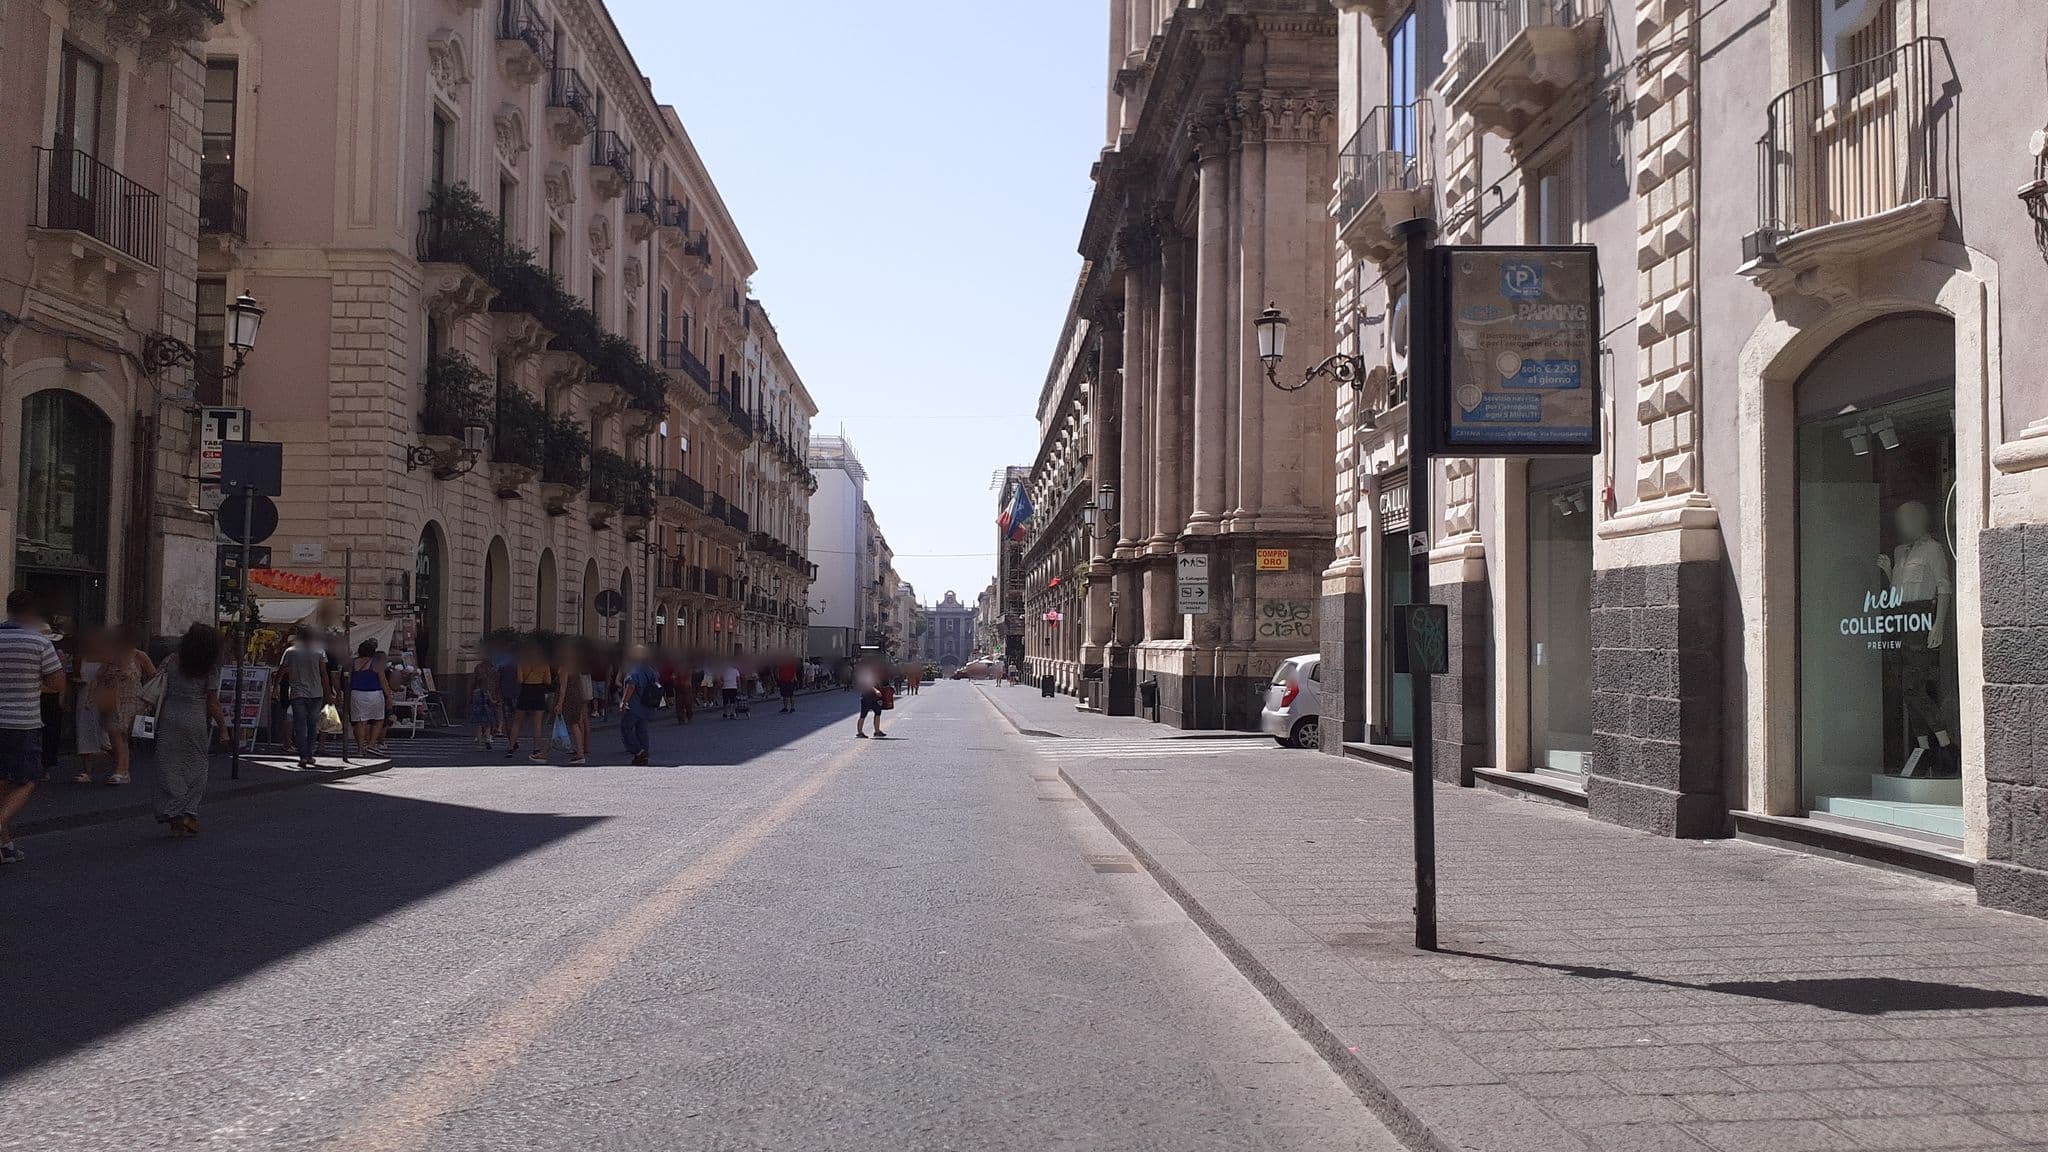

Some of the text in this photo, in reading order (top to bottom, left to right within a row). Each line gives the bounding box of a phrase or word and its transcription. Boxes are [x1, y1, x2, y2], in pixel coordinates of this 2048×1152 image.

[1519, 304, 1587, 321] PARKING
[1522, 365, 1542, 373] solo
[1528, 376, 1571, 386] al giorno
[1380, 487, 1410, 514] CALLI
[1257, 550, 1288, 558] COMPRO
[1263, 558, 1282, 566] ORO
[1863, 585, 1904, 613] new
[1840, 613, 1933, 635] COLLECTION
[1867, 640, 1902, 650] PREVIEW
